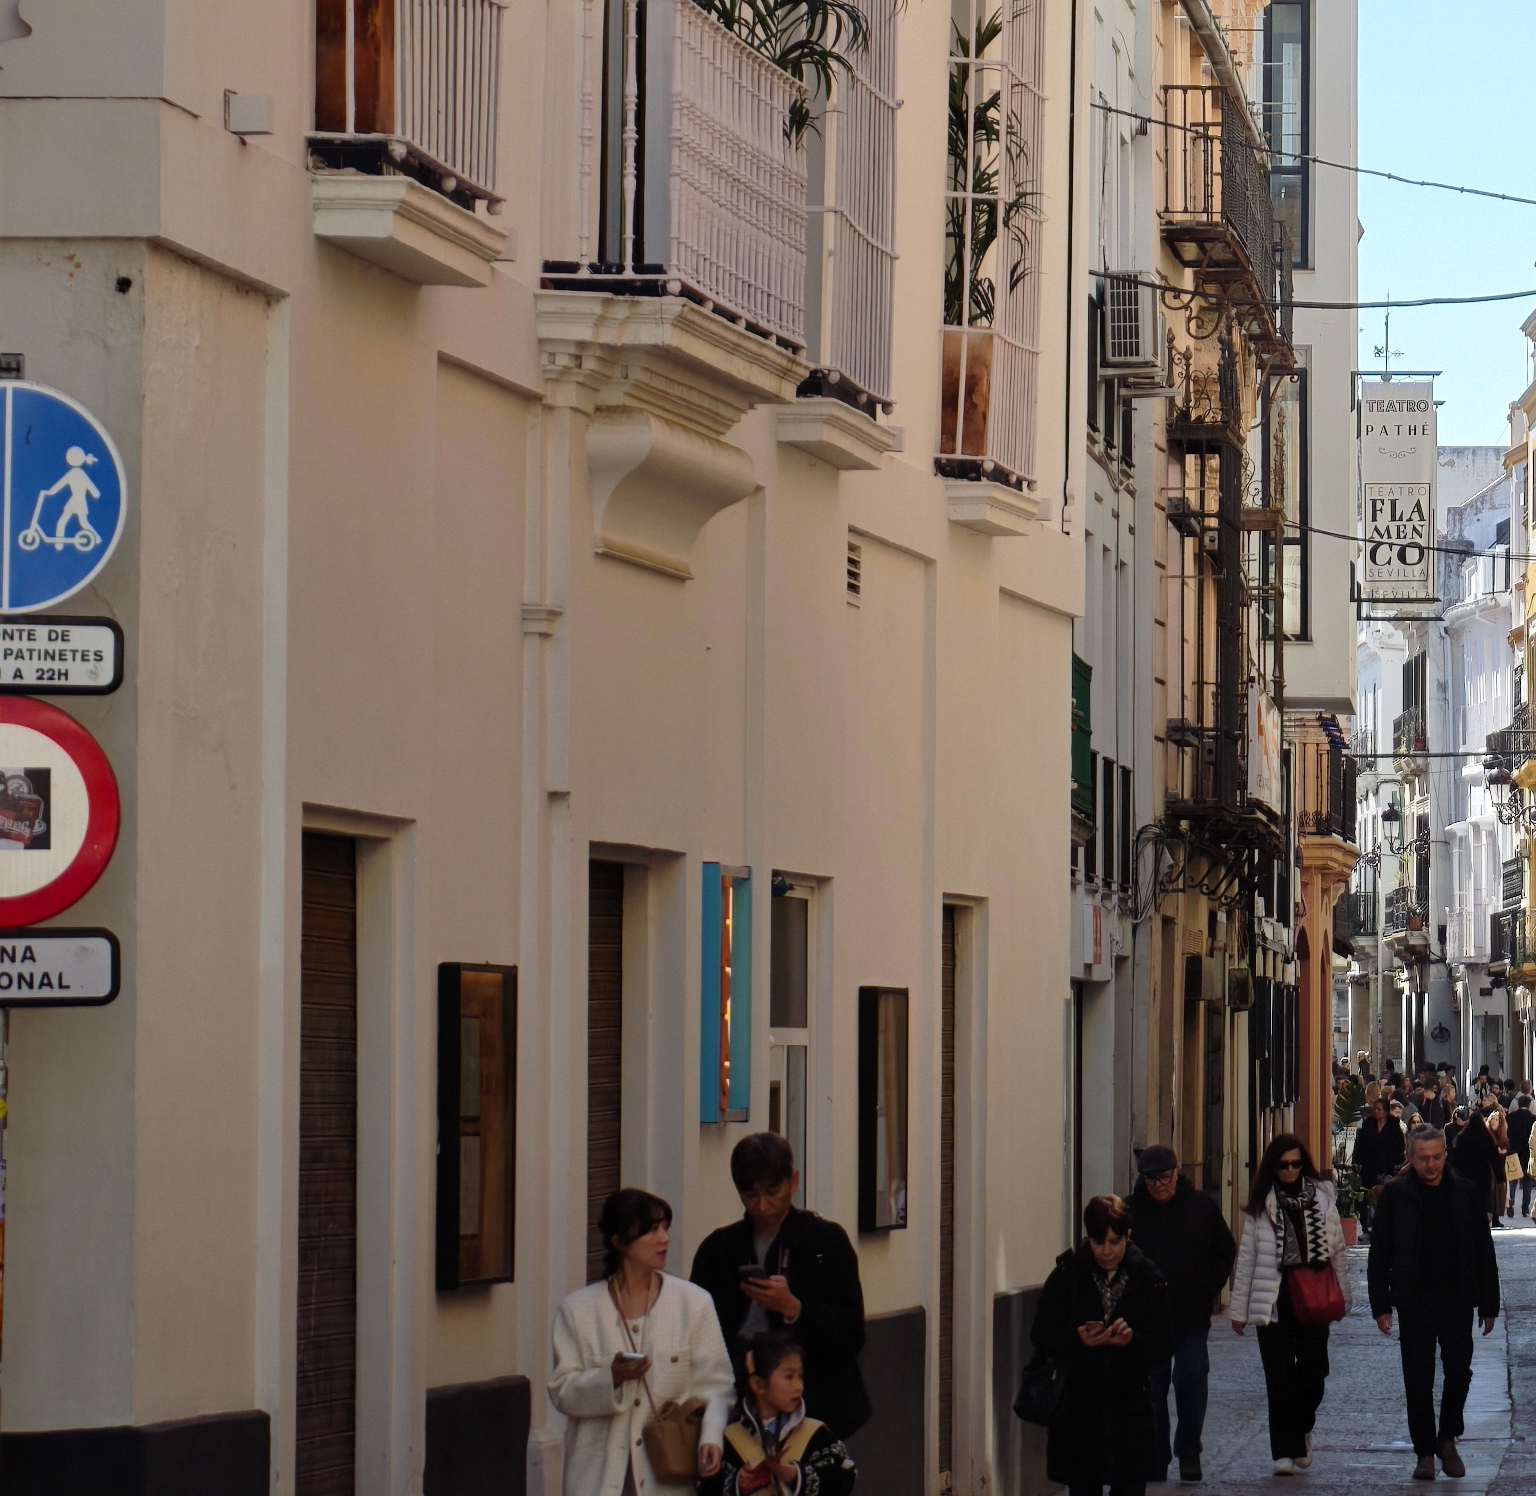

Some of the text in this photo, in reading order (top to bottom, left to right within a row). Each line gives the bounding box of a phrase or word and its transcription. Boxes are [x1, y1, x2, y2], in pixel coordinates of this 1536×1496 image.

[1366, 399, 1429, 413] TEATRO
[1365, 421, 1430, 436] PATHÉ
[1368, 486, 1427, 497] TEATRO
[1369, 498, 1427, 523] FLA
[1369, 523, 1425, 540] MEN
[1369, 541, 1425, 567] CO
[1368, 568, 1427, 578] SEVILLA
[0, 628, 71, 642] NTE DE
[3, 648, 104, 662] PATINETES
[12, 667, 69, 681] A 22H
